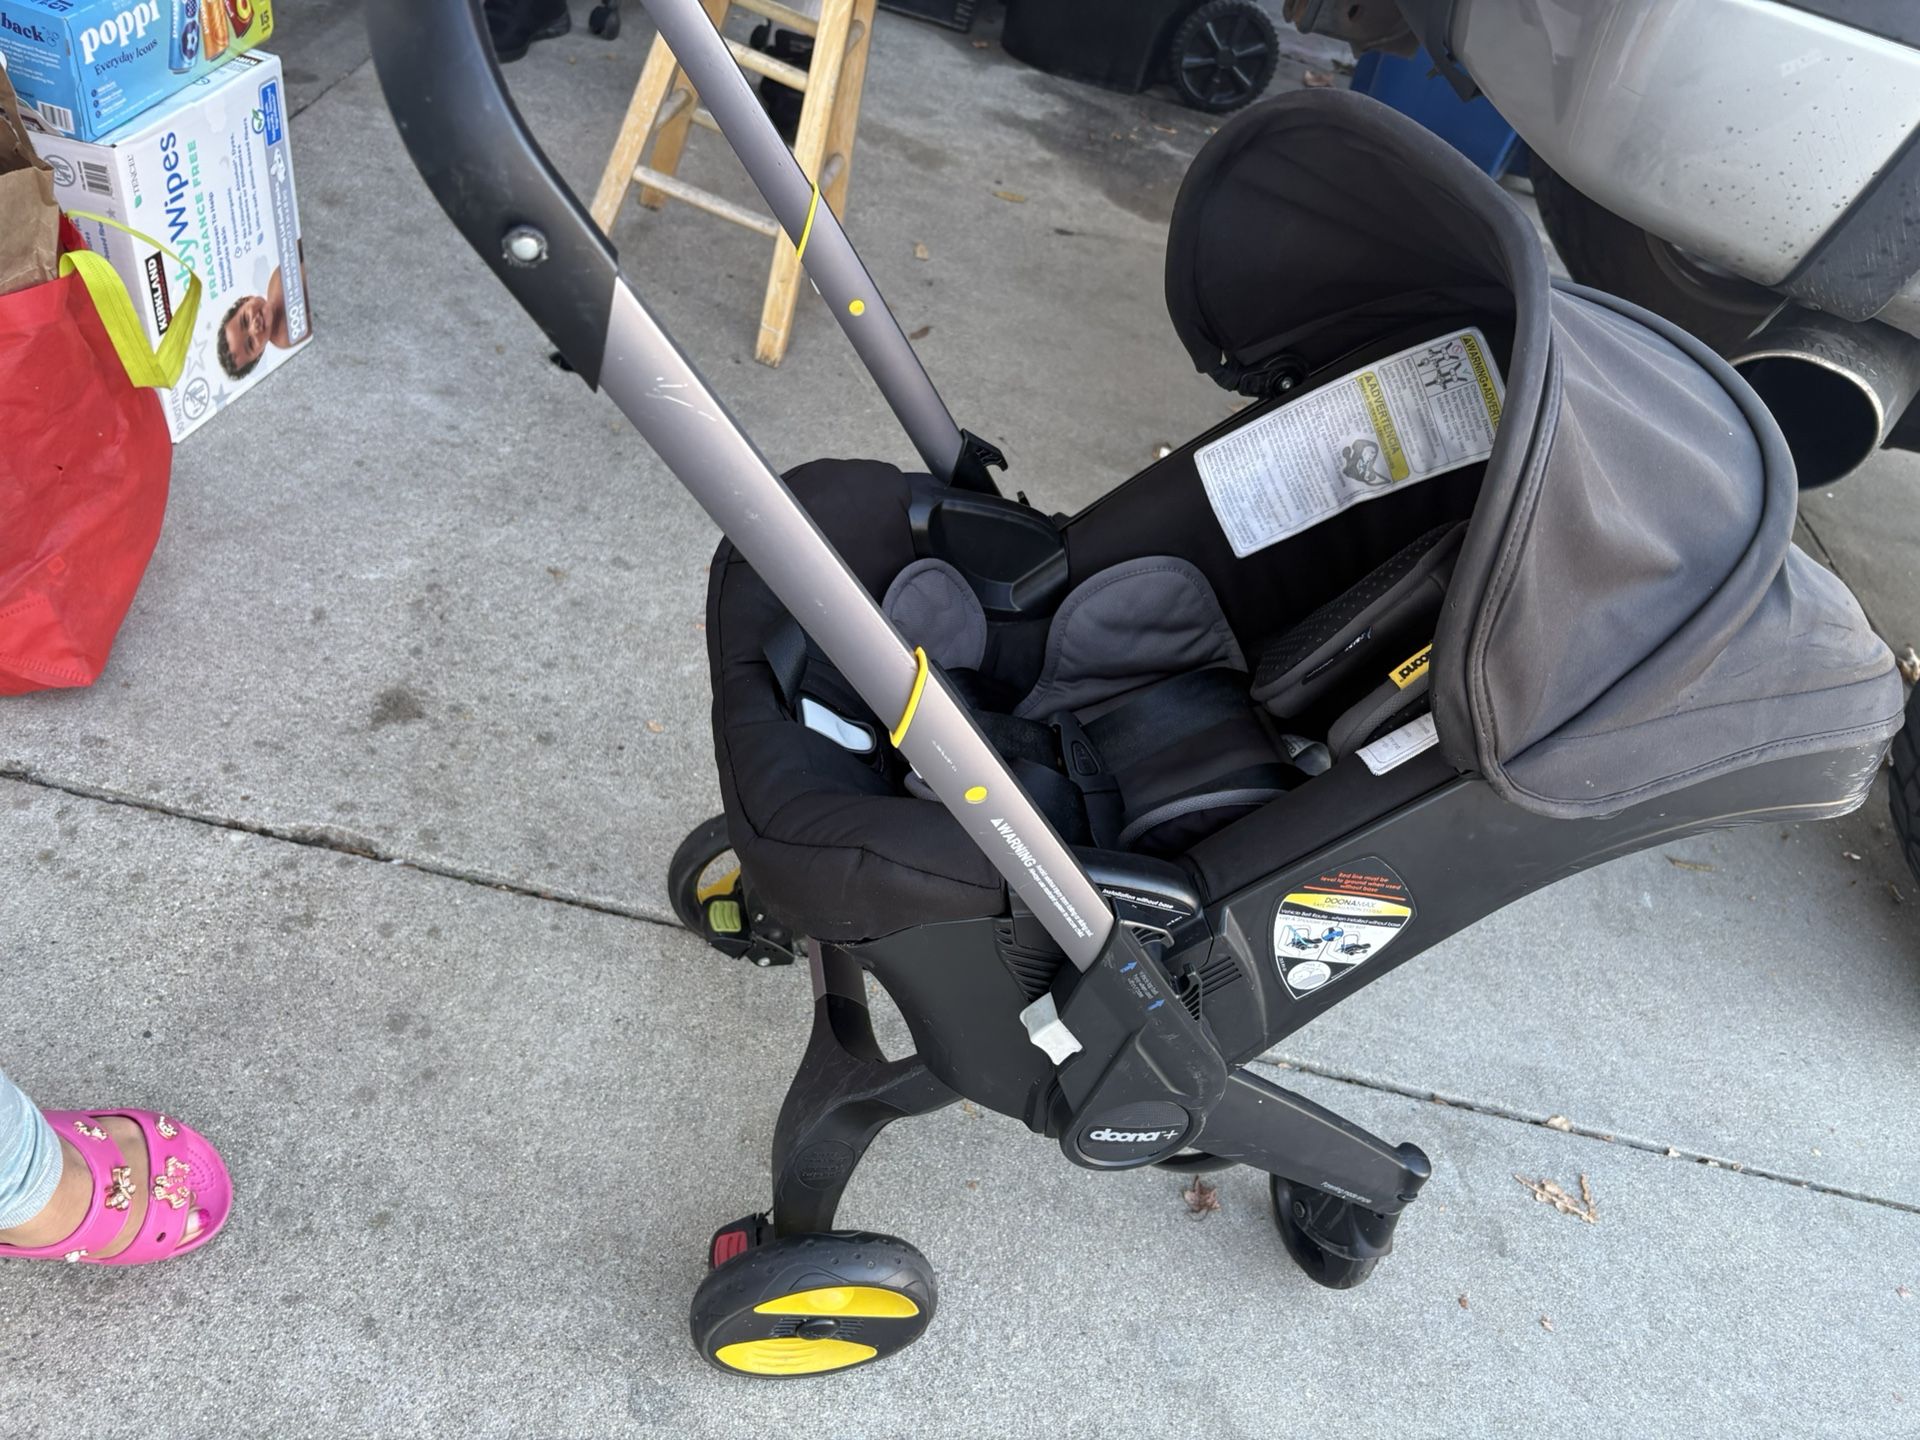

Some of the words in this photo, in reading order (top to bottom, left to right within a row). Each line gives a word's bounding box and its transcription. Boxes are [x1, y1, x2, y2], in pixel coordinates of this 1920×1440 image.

[0, 12, 46, 43] back
[79, 0, 161, 65] poppi
[94, 45, 135, 76] Everyday
[134, 39, 158, 62] Icons
[186, 139, 201, 187] FREE
[159, 131, 189, 242] wipes
[207, 191, 215, 212] Help
[194, 191, 218, 299] FRAGRANCE
[212, 225, 221, 255] Proven
[146, 258, 168, 330] KIRKLAND
[288, 305, 302, 339] 900
[1465, 341, 1488, 384] WARNING
[168, 387, 180, 404] FLU
[171, 403, 183, 422] NOT
[1367, 381, 1400, 455] ADVERTENCIA
[1398, 651, 1432, 679] oona
[996, 821, 1037, 869] WARNING
[1135, 895, 1158, 905] without
[1157, 900, 1174, 909] base
[1324, 895, 1375, 909] DOONAMAX
